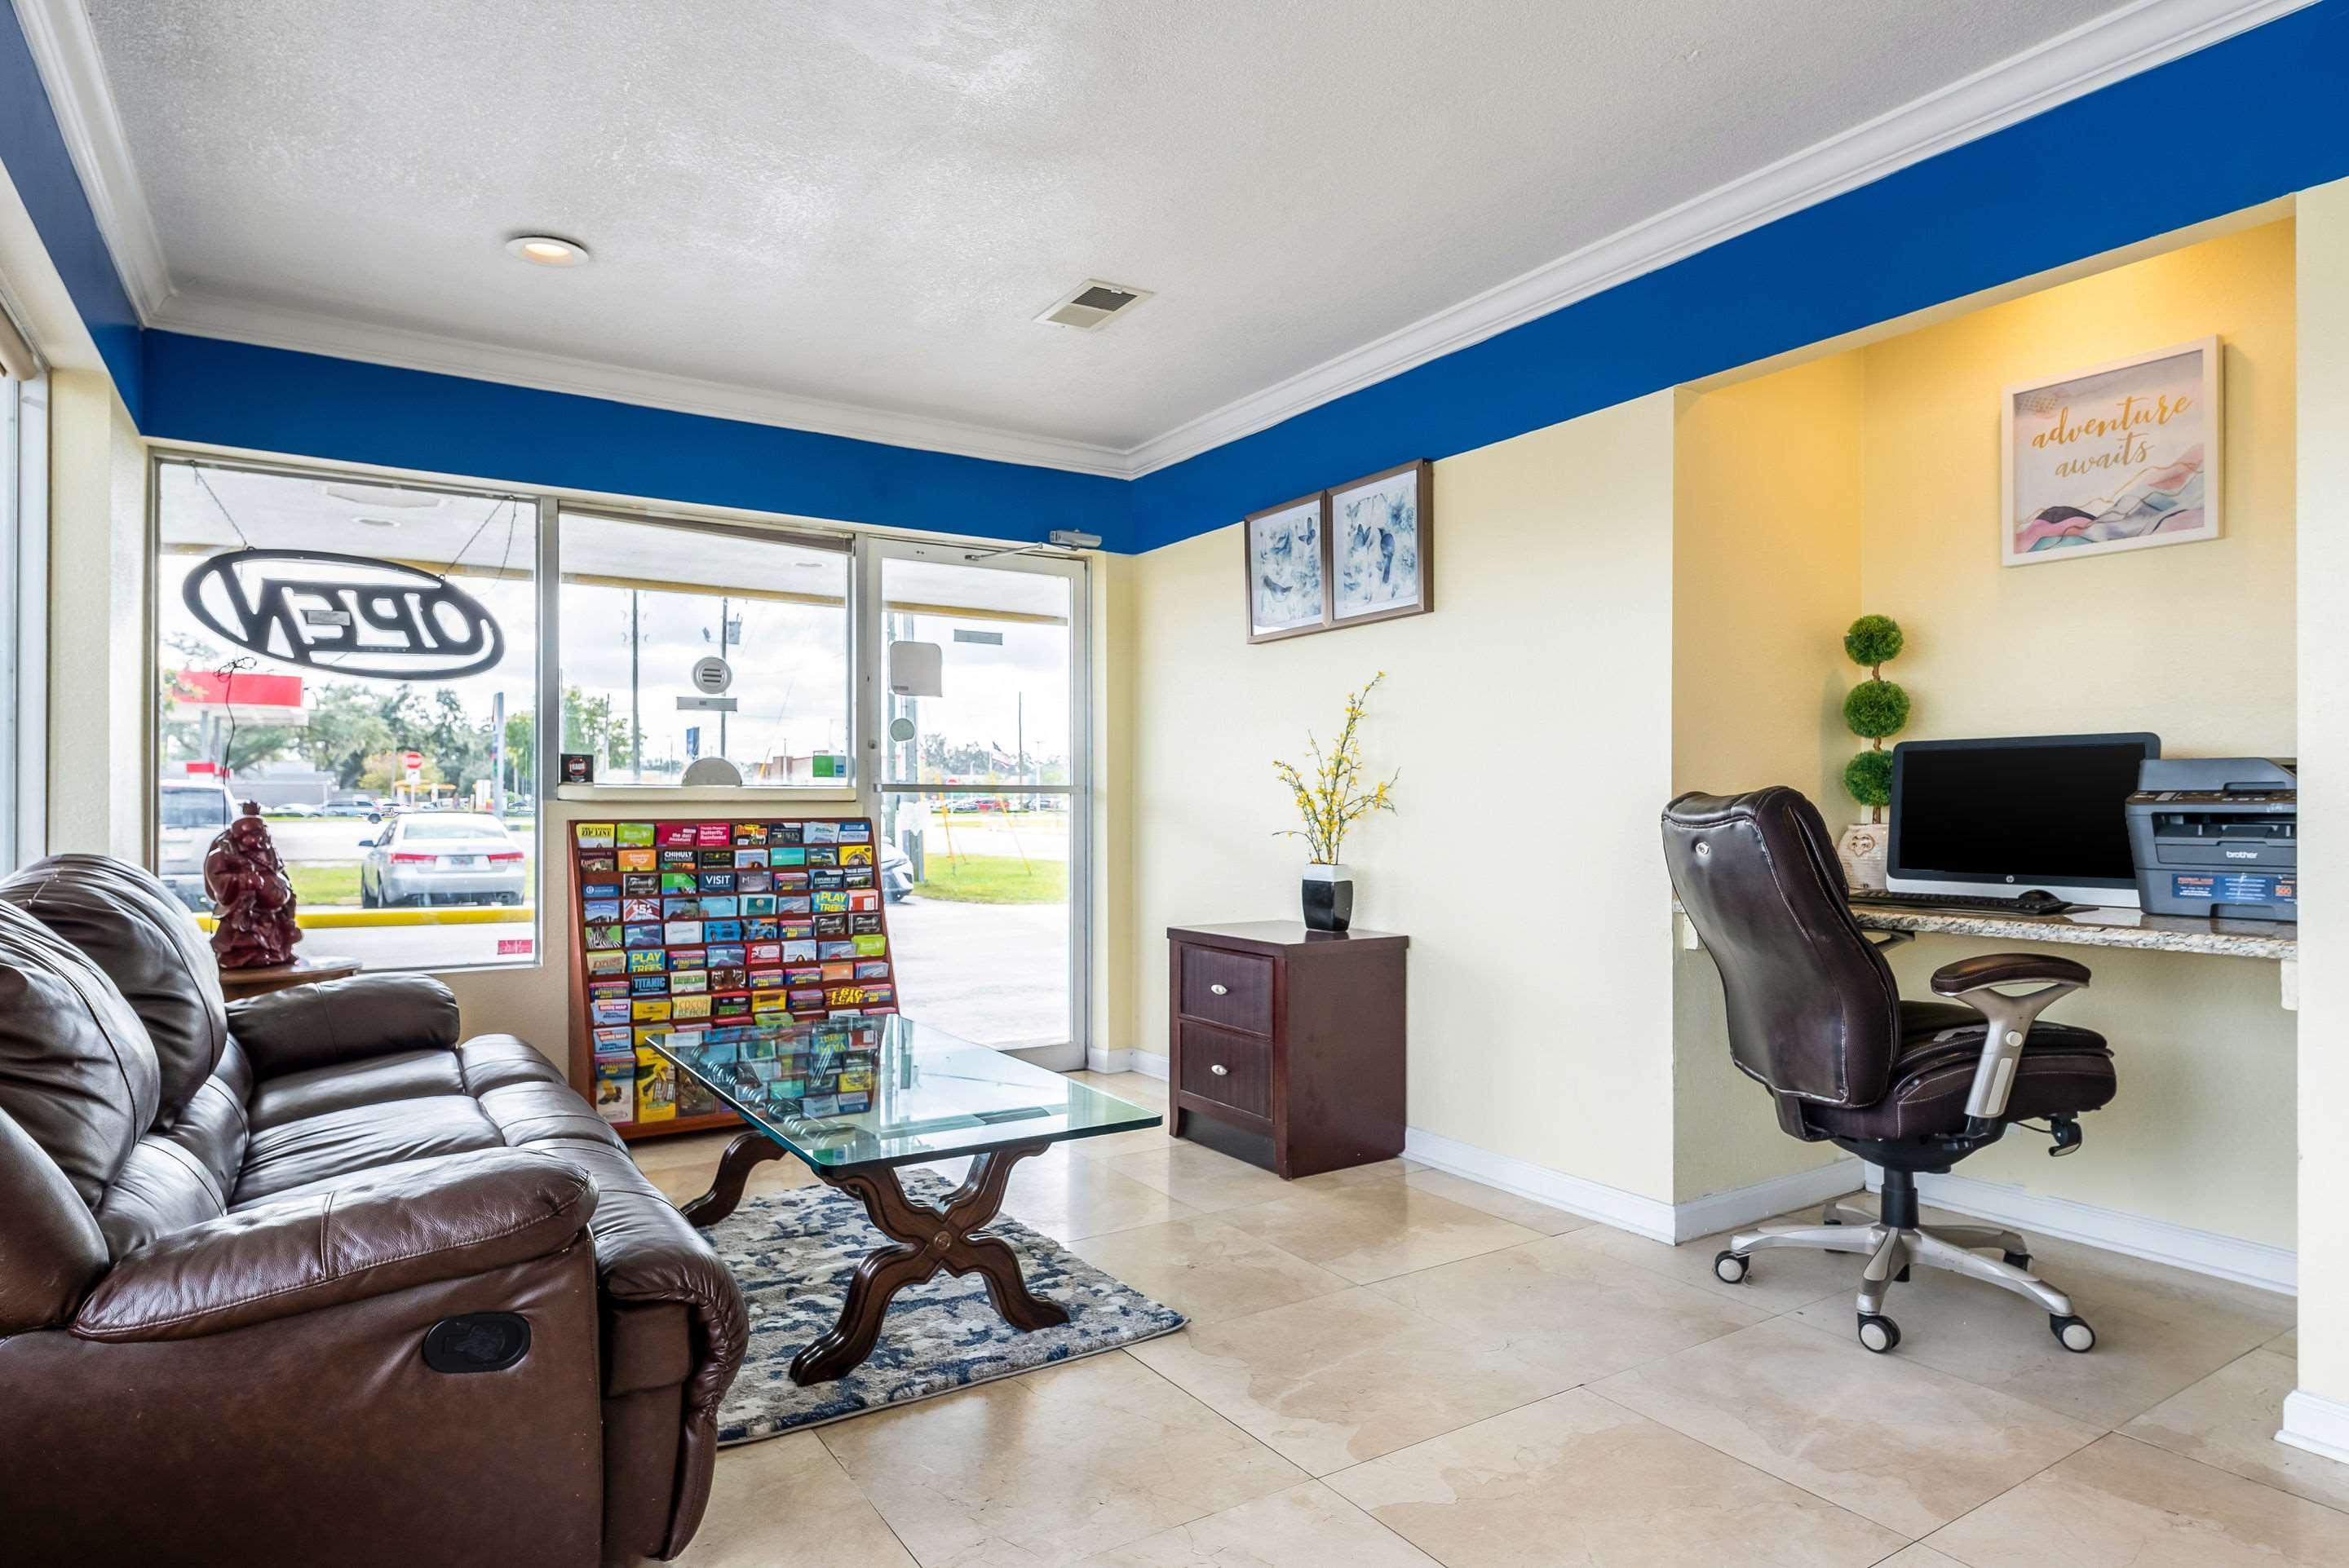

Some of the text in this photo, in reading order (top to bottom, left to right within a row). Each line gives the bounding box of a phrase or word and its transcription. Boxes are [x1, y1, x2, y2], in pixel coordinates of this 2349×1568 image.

[2032, 395, 2193, 448] adventure
[2055, 431, 2155, 478] awaits
[2226, 850, 2258, 859] brother
[705, 875, 731, 885] VISIT
[821, 891, 847, 903] PLAY
[632, 952, 662, 962] PLAY
[634, 977, 666, 988] TITANIC
[840, 987, 864, 997] BIG
[679, 998, 708, 1009] COCOA
